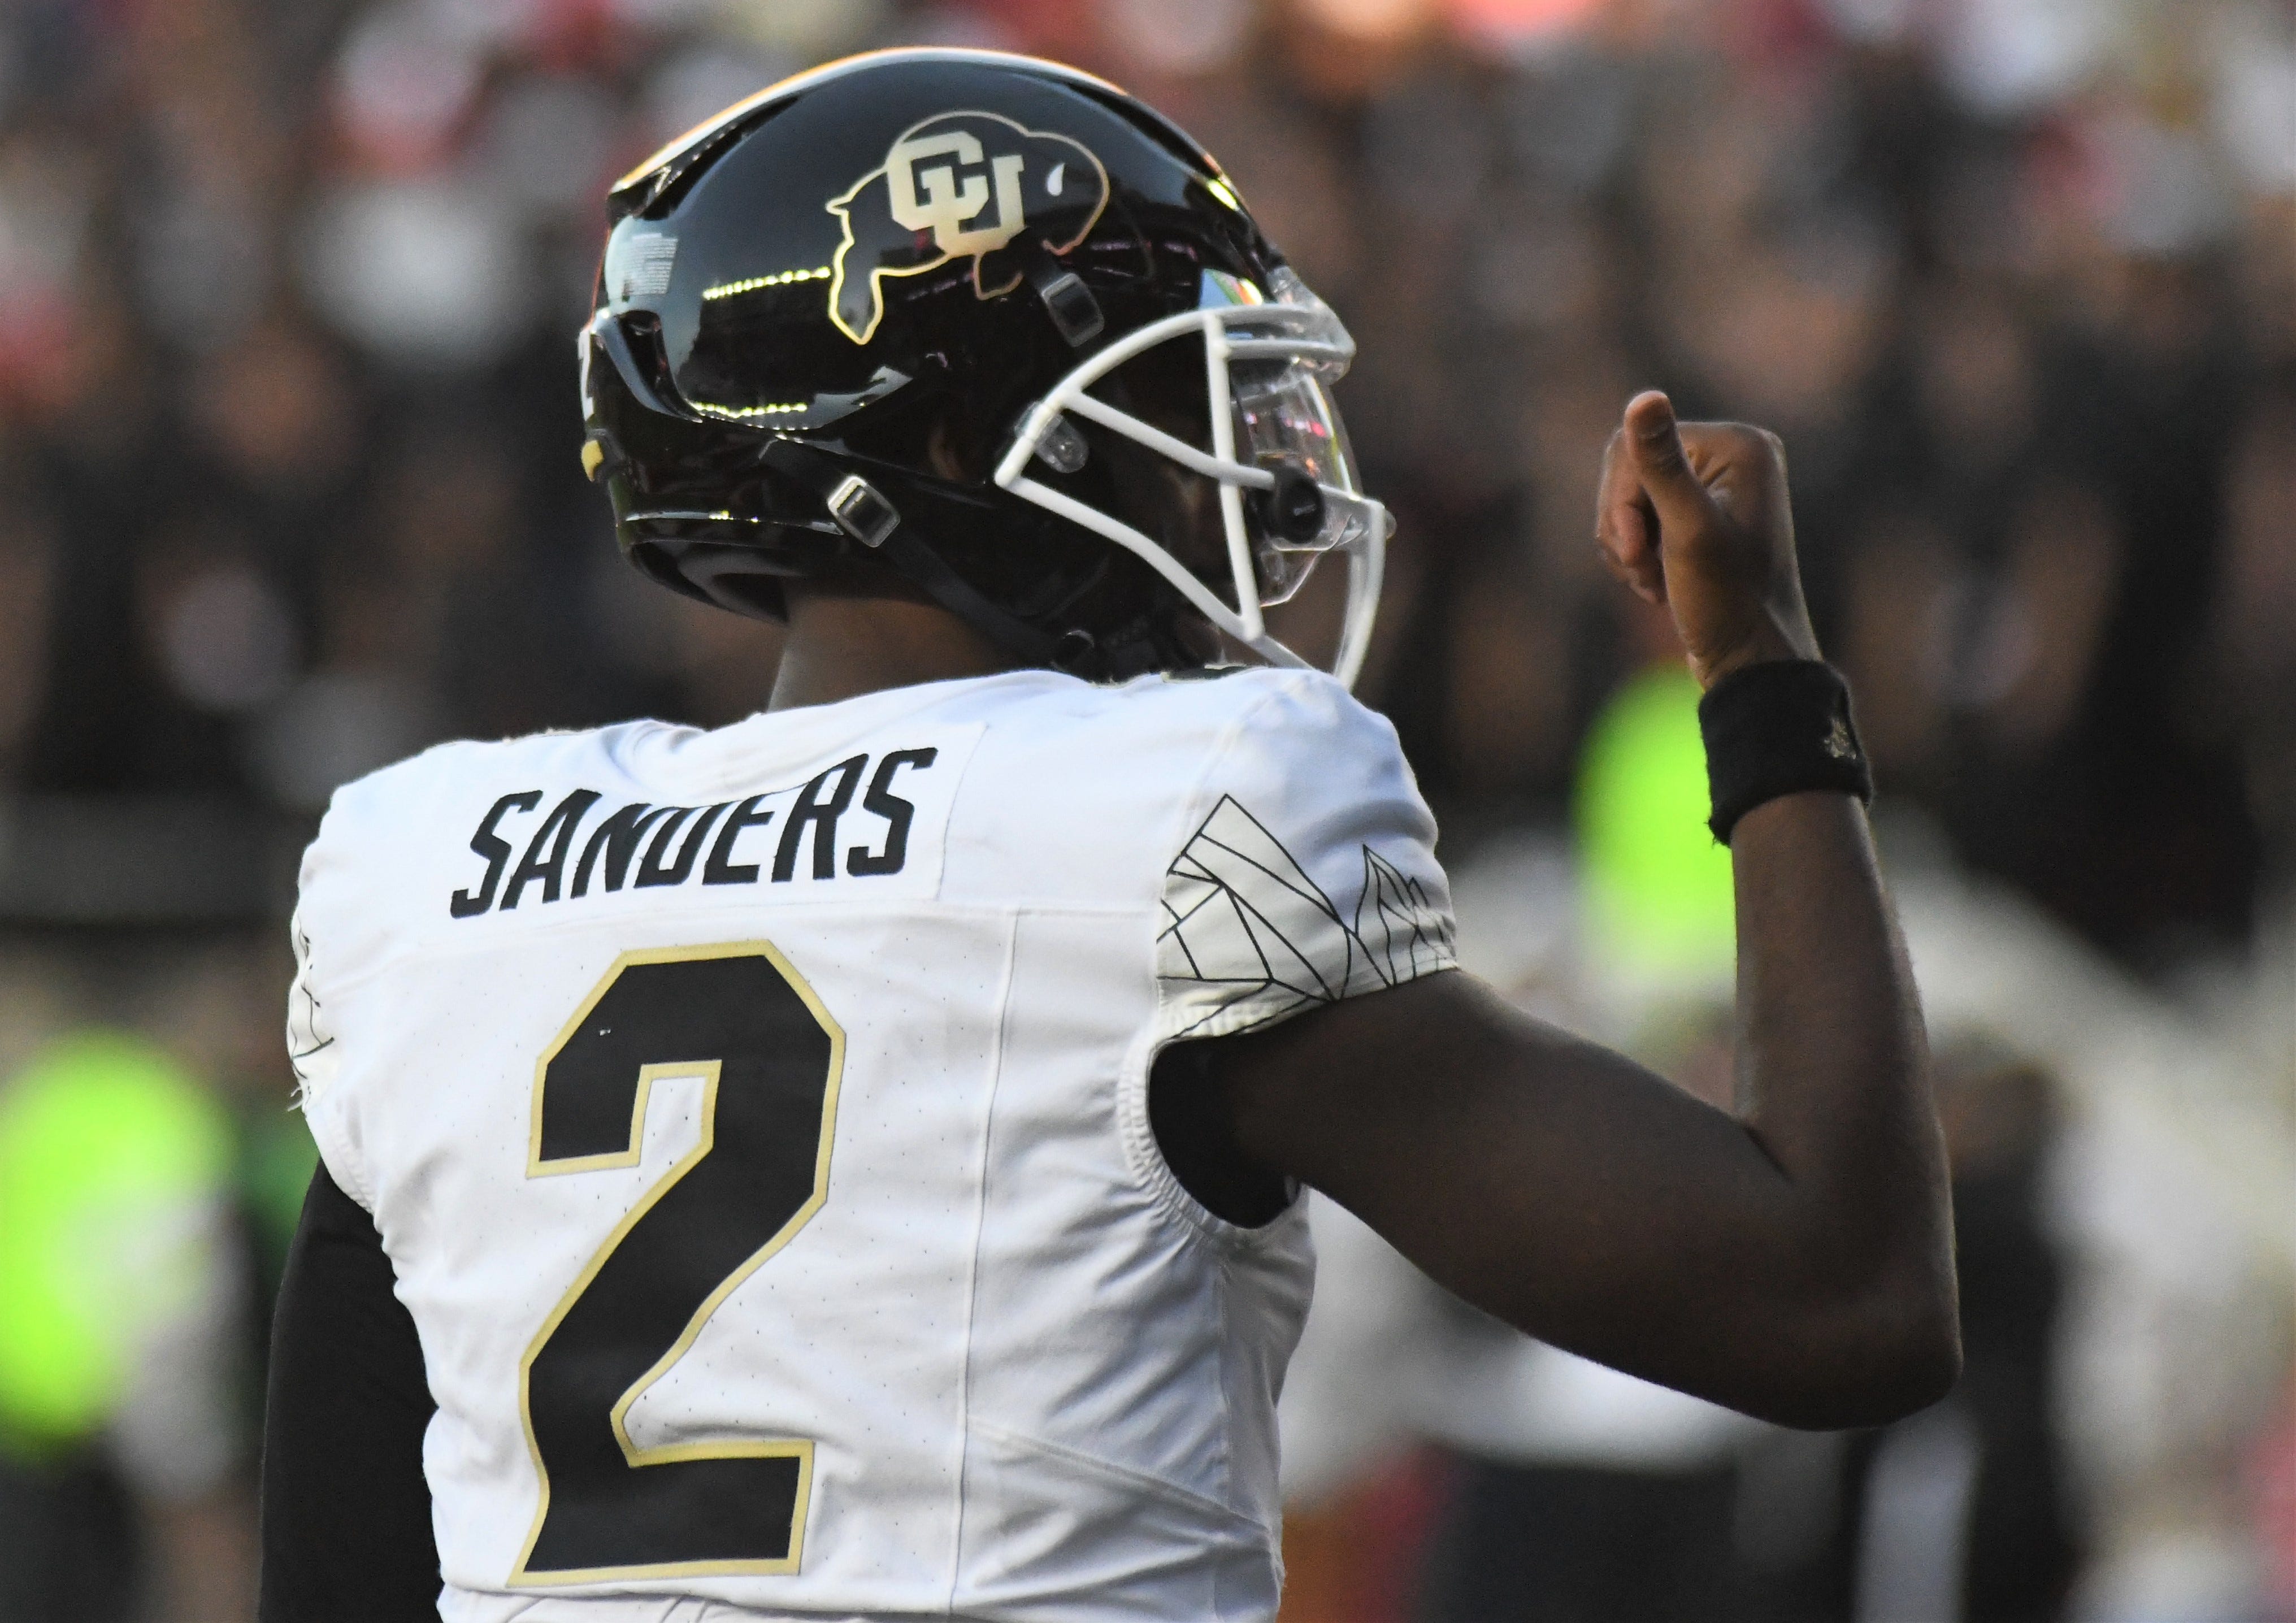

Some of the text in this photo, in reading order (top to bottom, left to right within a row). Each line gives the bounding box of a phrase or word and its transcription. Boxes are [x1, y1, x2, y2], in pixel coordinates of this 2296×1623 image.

[886, 131, 1028, 257] CU
[450, 747, 938, 919] SANDERS
[506, 939, 845, 1587] 2
